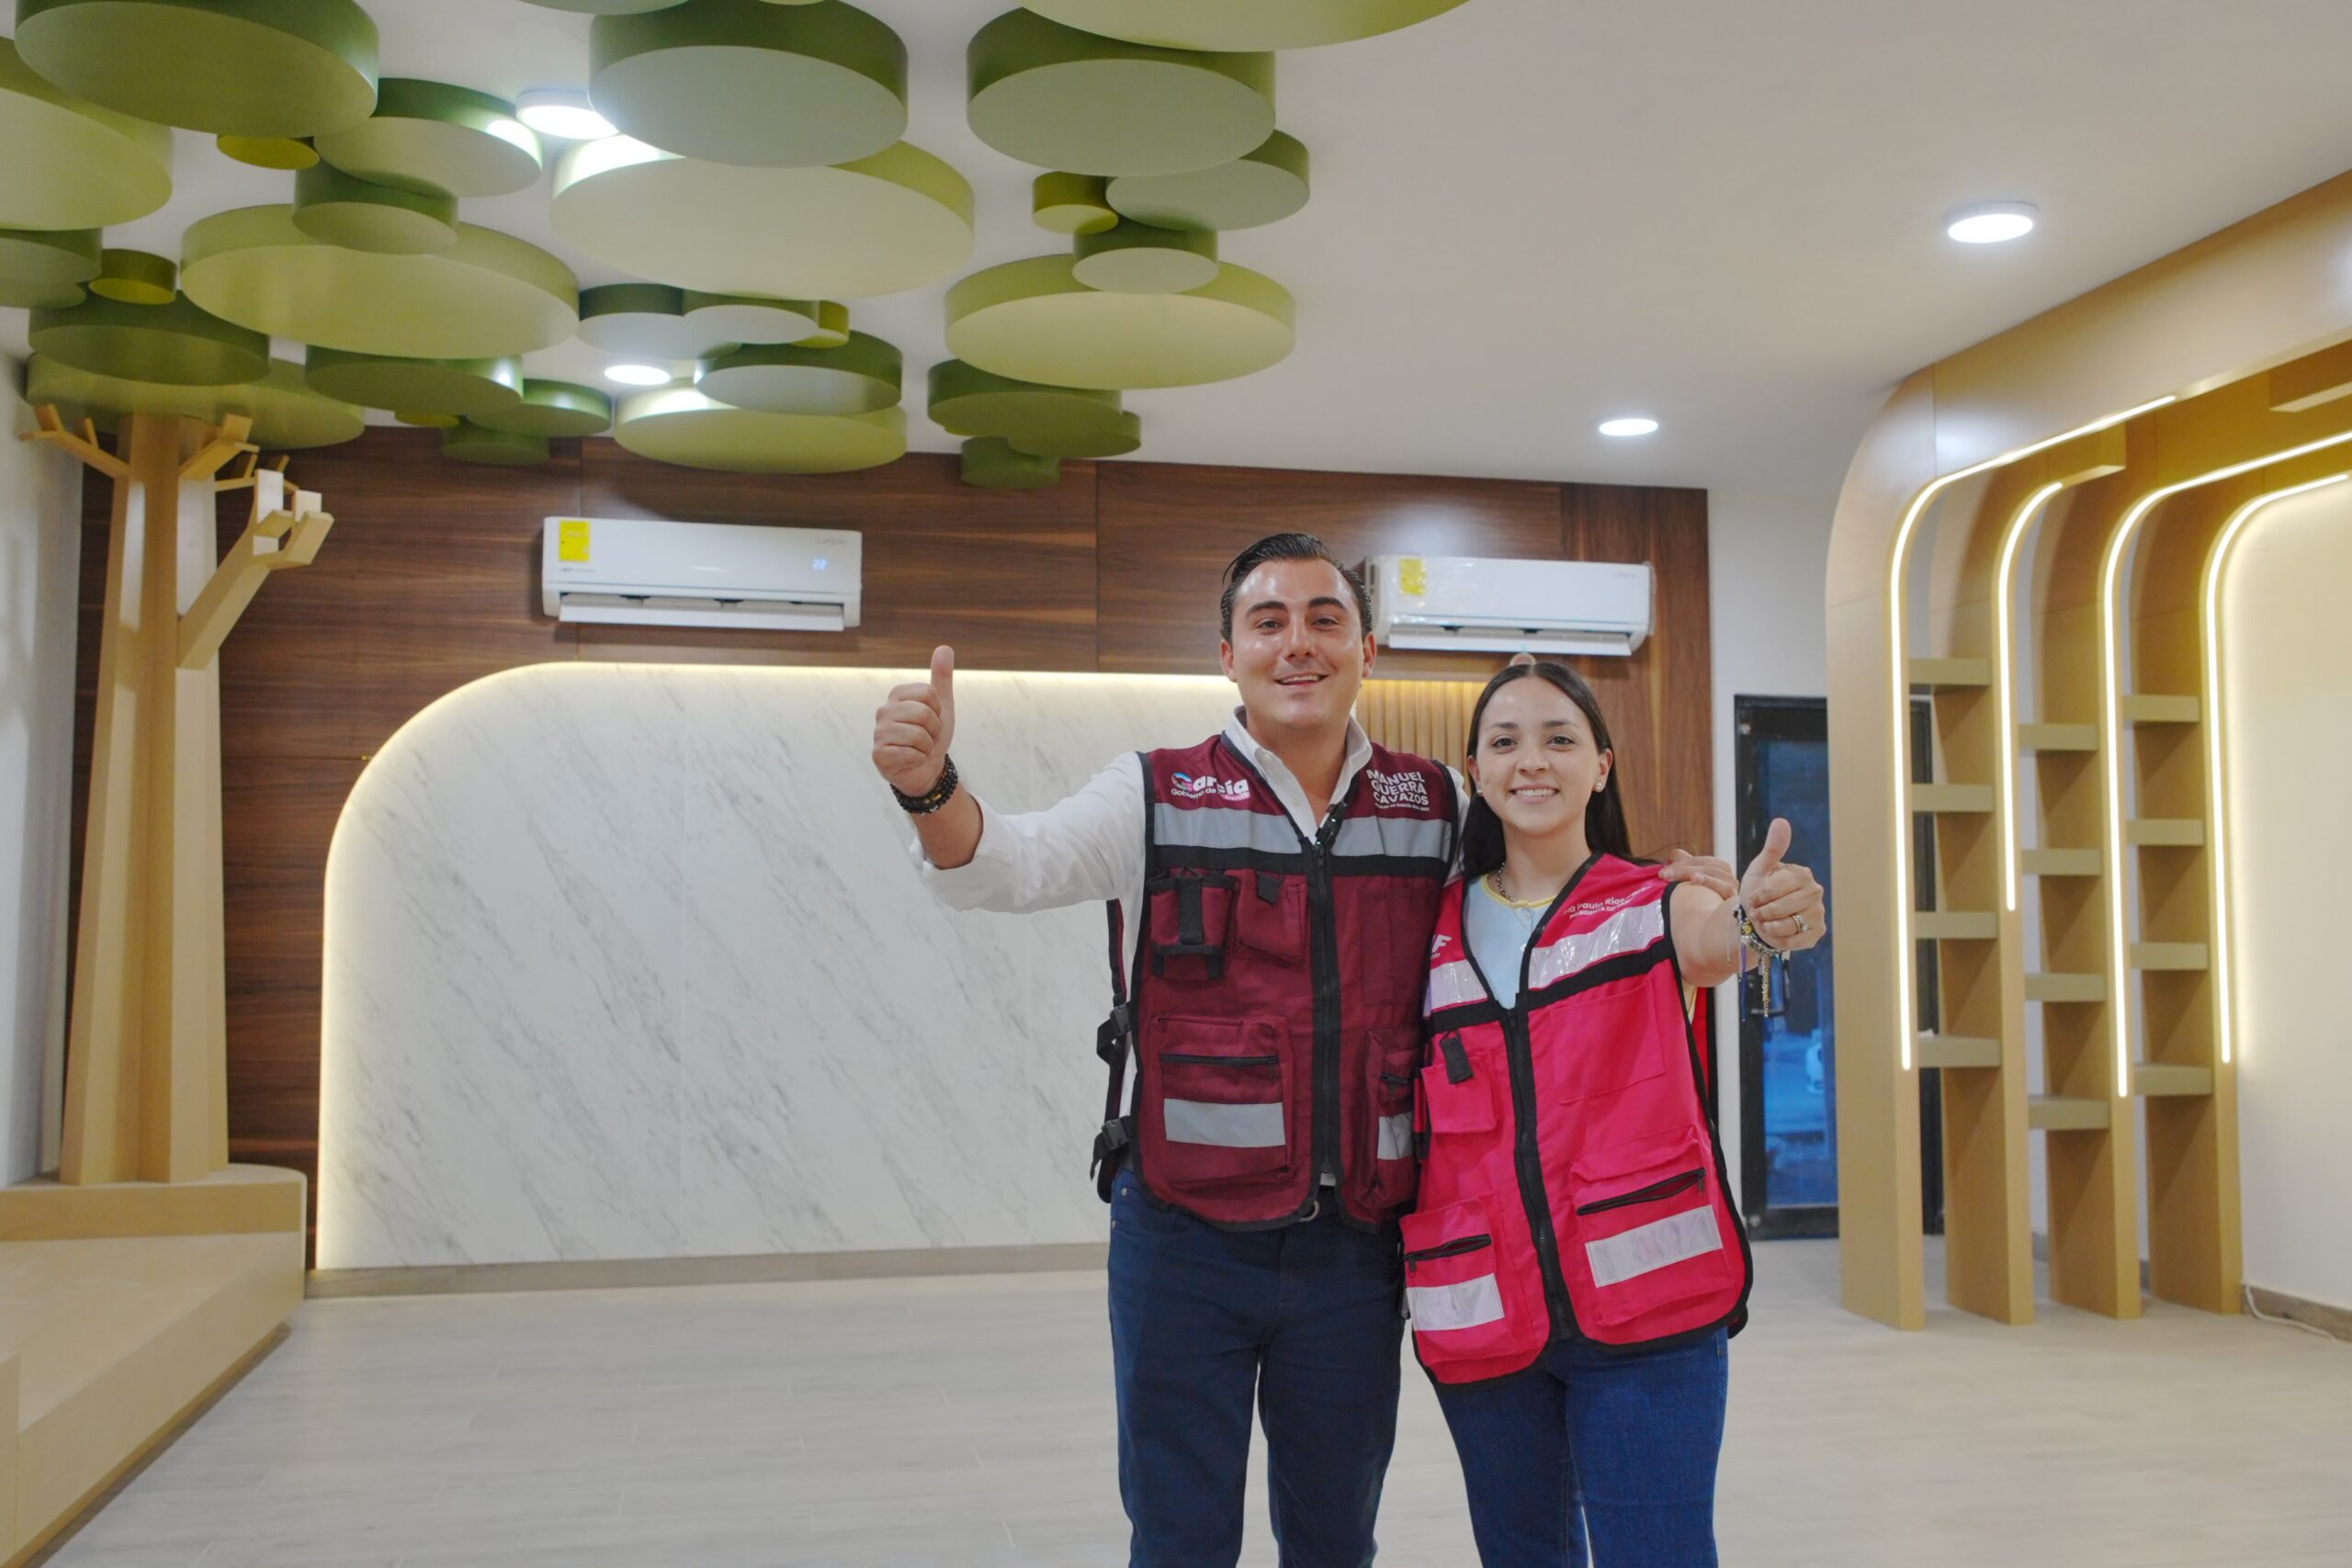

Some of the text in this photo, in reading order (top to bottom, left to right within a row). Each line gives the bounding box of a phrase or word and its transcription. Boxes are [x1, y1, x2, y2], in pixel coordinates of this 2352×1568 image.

[1366, 769, 1425, 785] MANUEL
[1371, 780, 1428, 795] GUERRA
[1374, 791, 1429, 805] CAVAZOS
